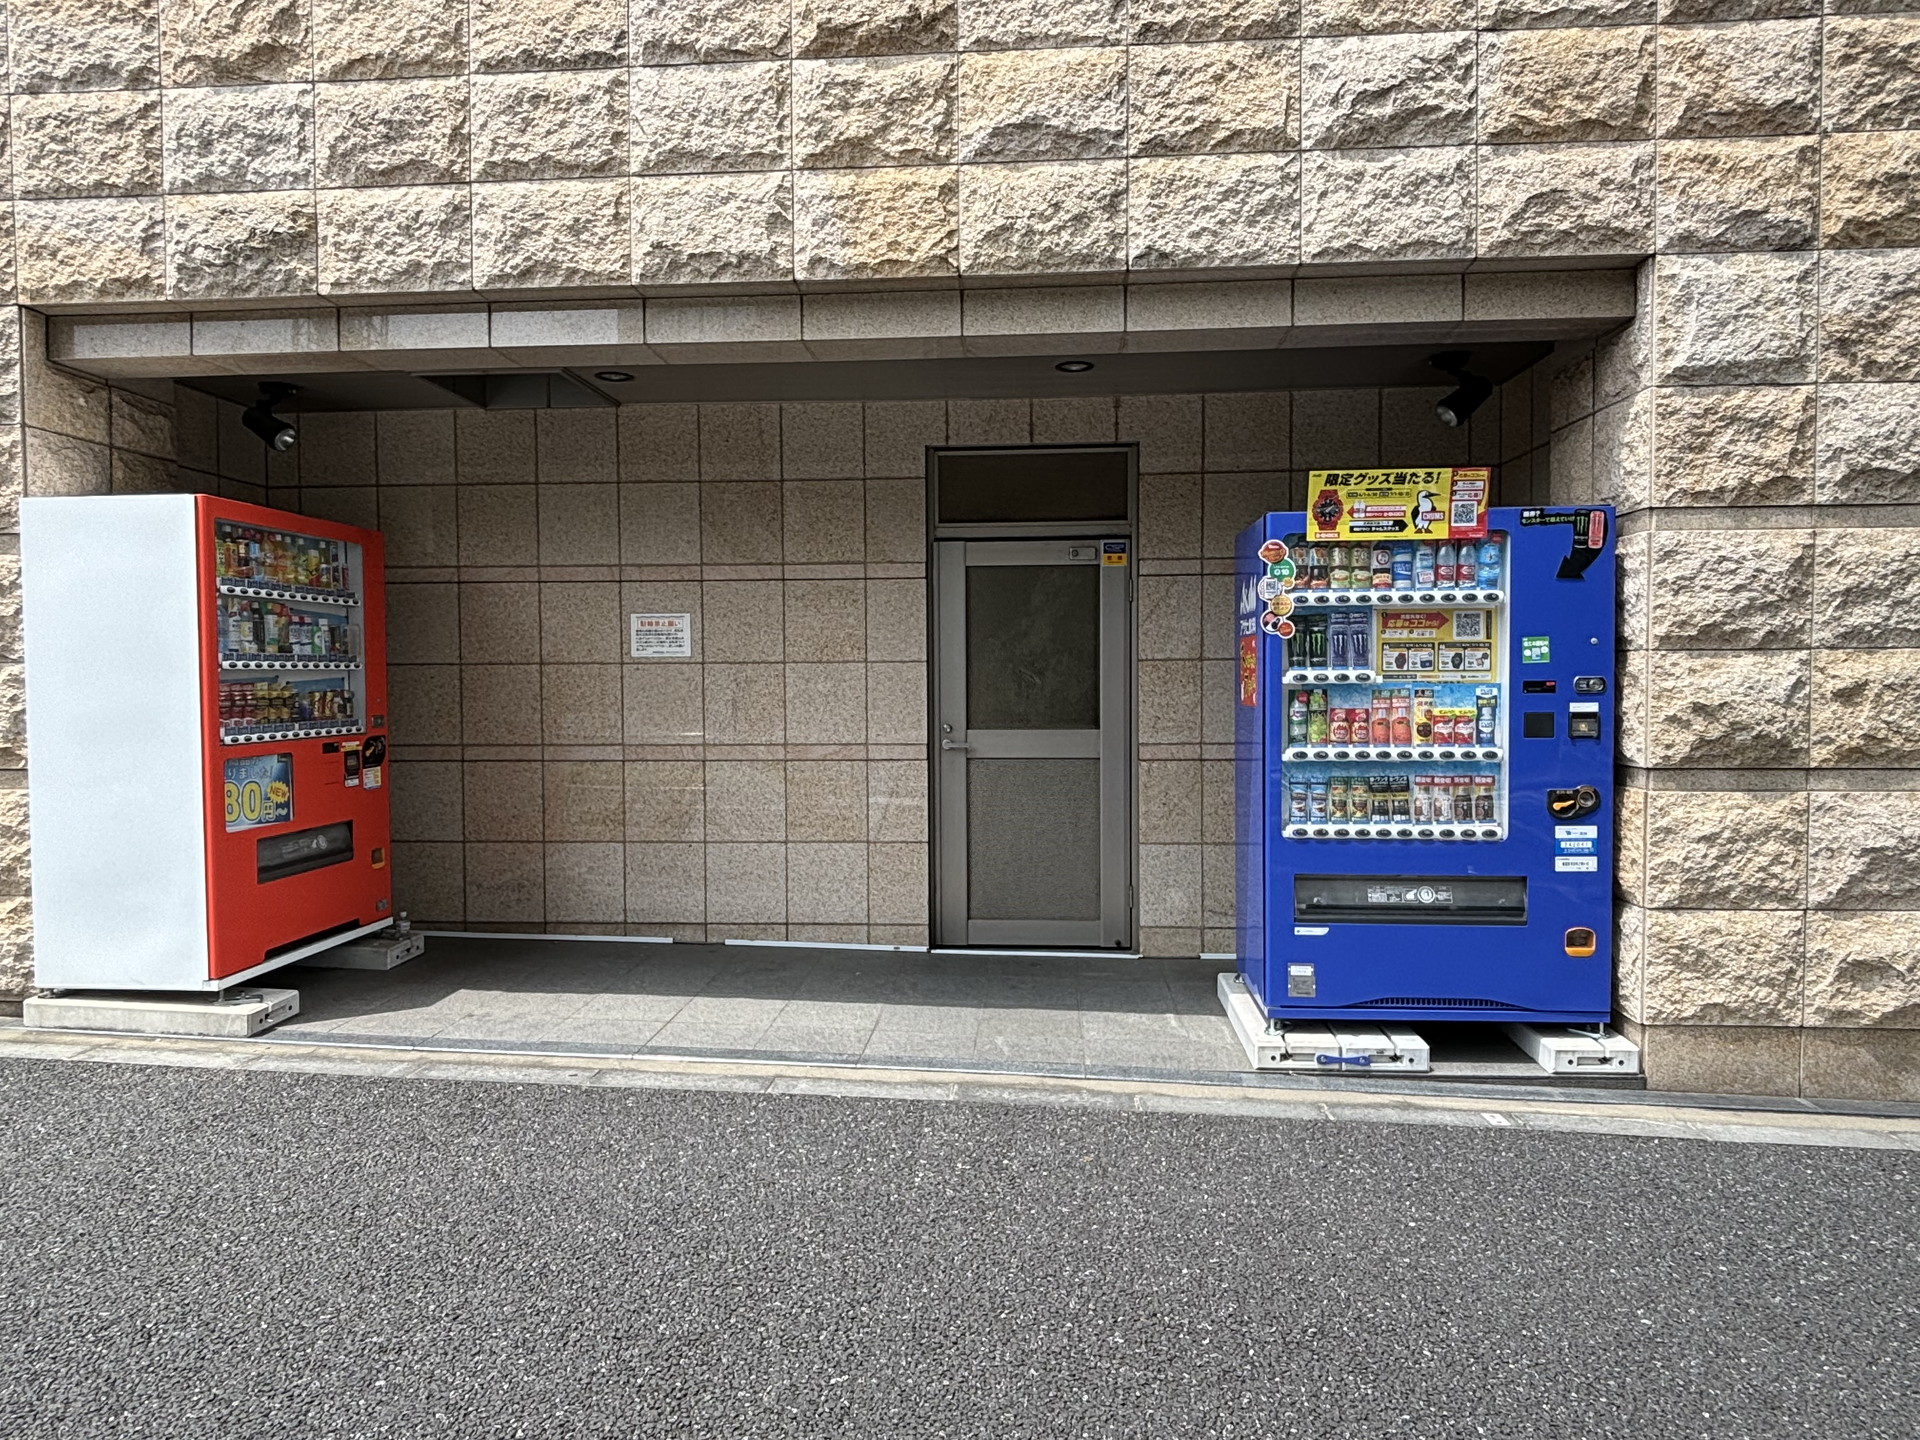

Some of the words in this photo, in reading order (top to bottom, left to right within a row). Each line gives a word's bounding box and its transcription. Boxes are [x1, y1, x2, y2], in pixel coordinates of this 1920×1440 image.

[1324, 471, 1442, 487] 限定グッズ当たる!
[1422, 512, 1445, 521] CHUMS
[1386, 619, 1440, 628] 応募はココから!
[269, 785, 289, 799] NEW
